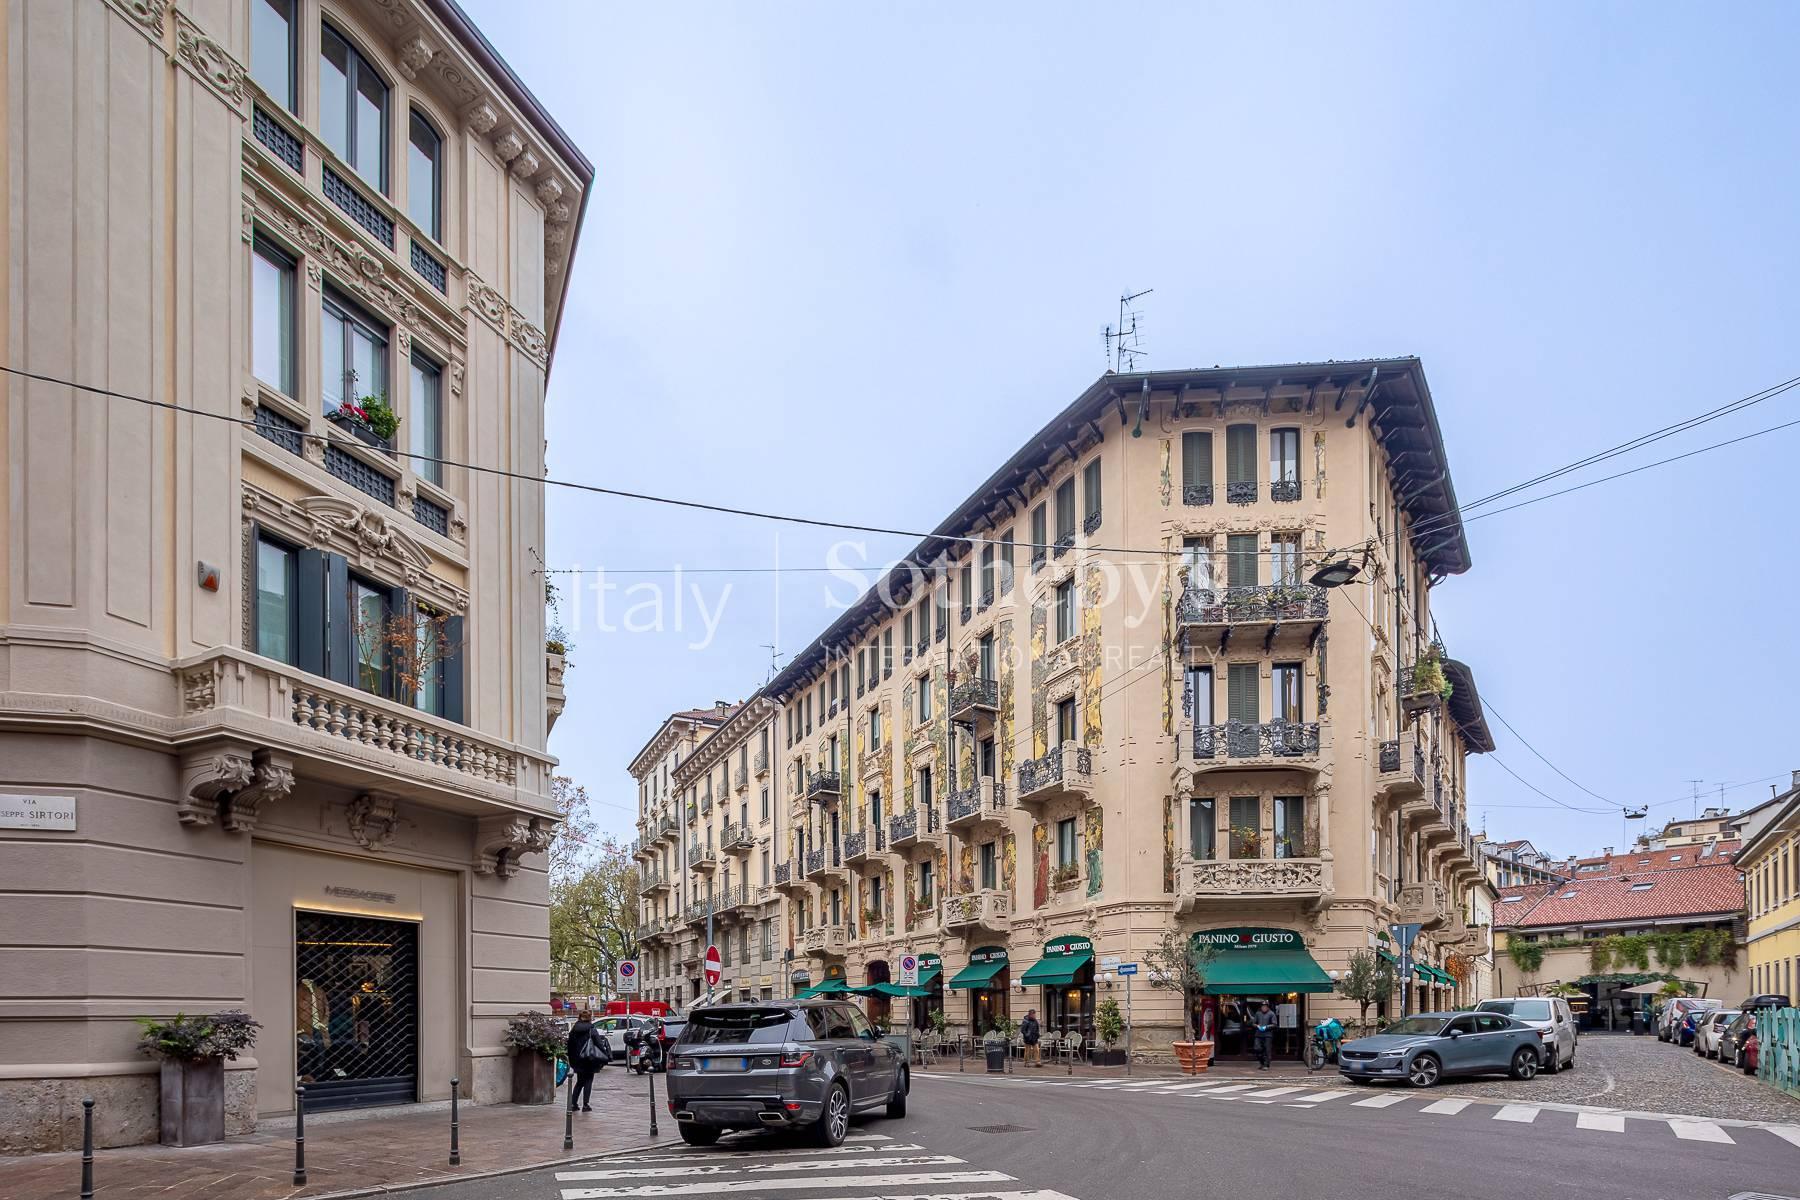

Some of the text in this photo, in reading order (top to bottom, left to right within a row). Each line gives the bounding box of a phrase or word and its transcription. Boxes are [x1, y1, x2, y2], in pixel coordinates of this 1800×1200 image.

[29, 810, 74, 820] SIRTORI
[1198, 933, 1294, 944] PANINO GIUSTO
[1046, 944, 1066, 953] PANINO
[1069, 941, 1091, 951] GIUSTO
